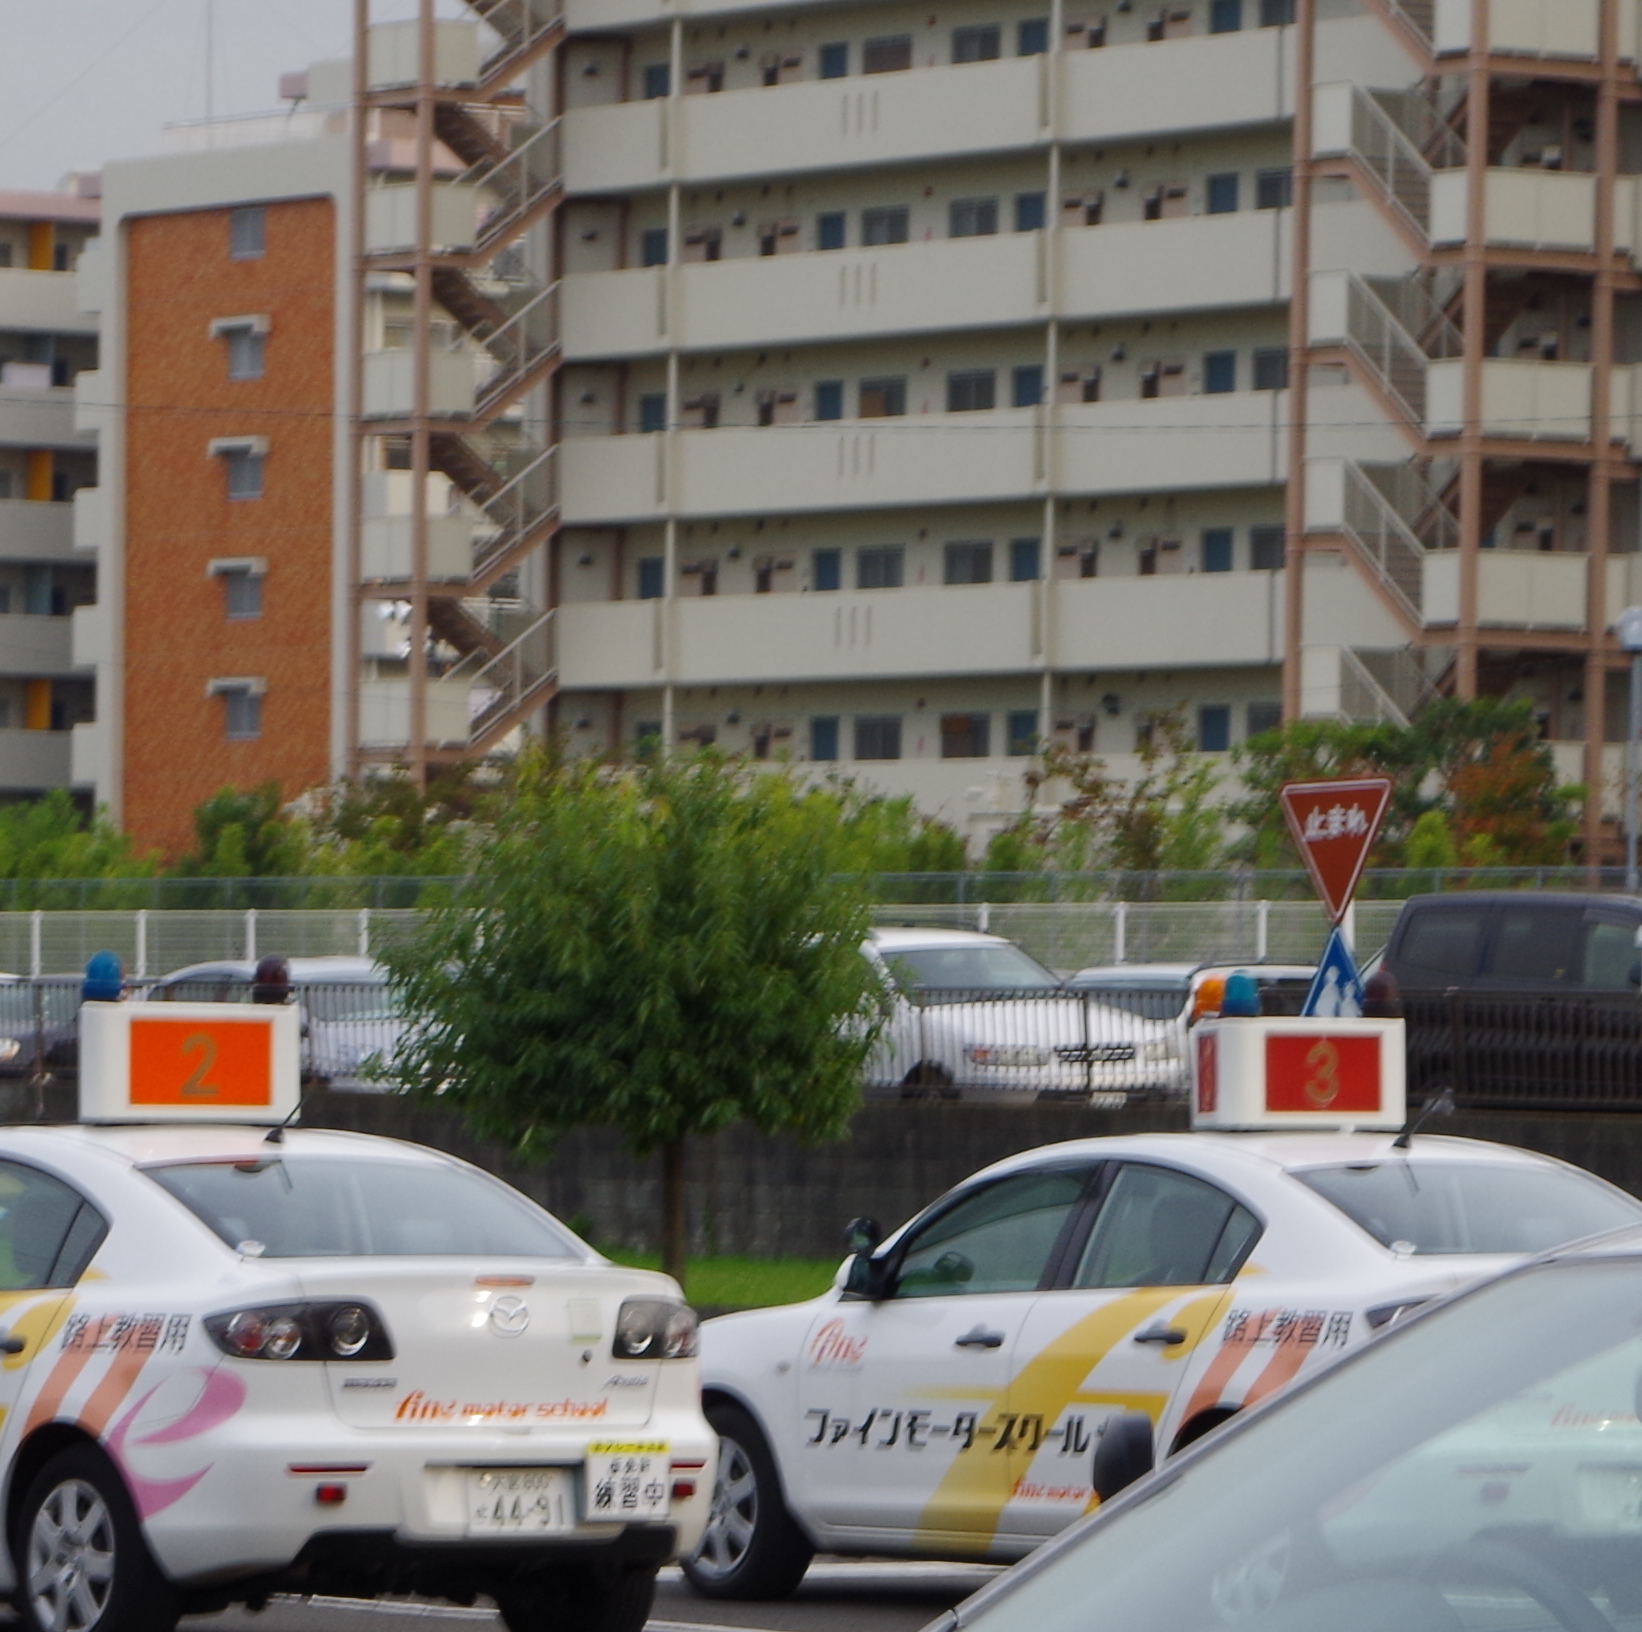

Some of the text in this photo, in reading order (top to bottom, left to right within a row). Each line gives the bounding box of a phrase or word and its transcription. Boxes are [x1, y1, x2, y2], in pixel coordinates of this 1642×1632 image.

[1306, 803, 1369, 841] 止まれ
[181, 1032, 219, 1096] 2
[1305, 1040, 1339, 1107] 3
[61, 1311, 192, 1353] 路上教習用
[1223, 1309, 1354, 1346] 路上教習用
[395, 1389, 608, 1422] fine motor school
[805, 1408, 1110, 1455] ファインモータースクール
[493, 1495, 567, 1526] 44-91
